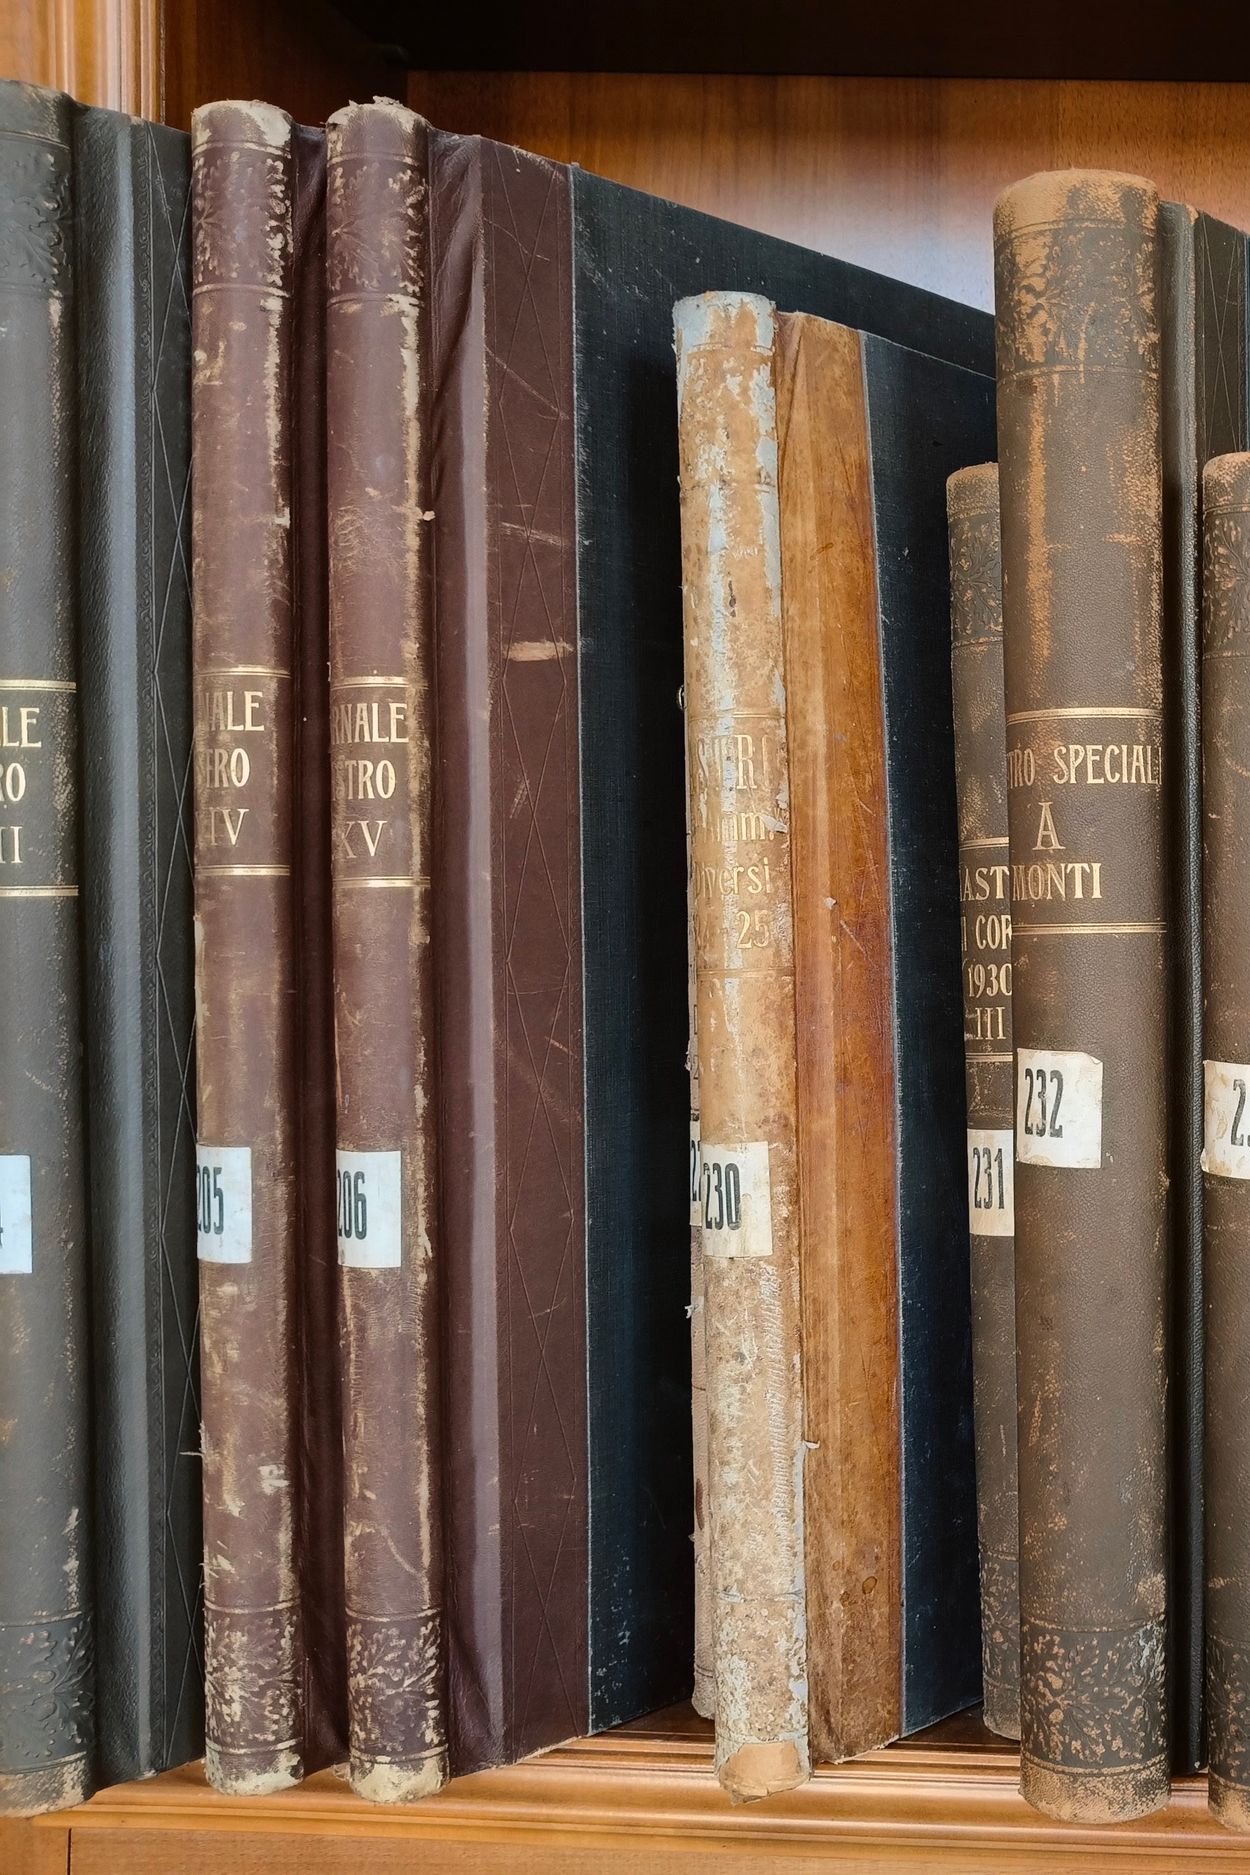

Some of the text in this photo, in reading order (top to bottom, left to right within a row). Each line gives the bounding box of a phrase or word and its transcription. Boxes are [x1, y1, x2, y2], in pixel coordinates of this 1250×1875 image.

[1032, 801, 1066, 850] A
[1024, 1067, 1065, 1139] 232
[703, 1162, 742, 1231] 230
[972, 1147, 1006, 1210] 231
